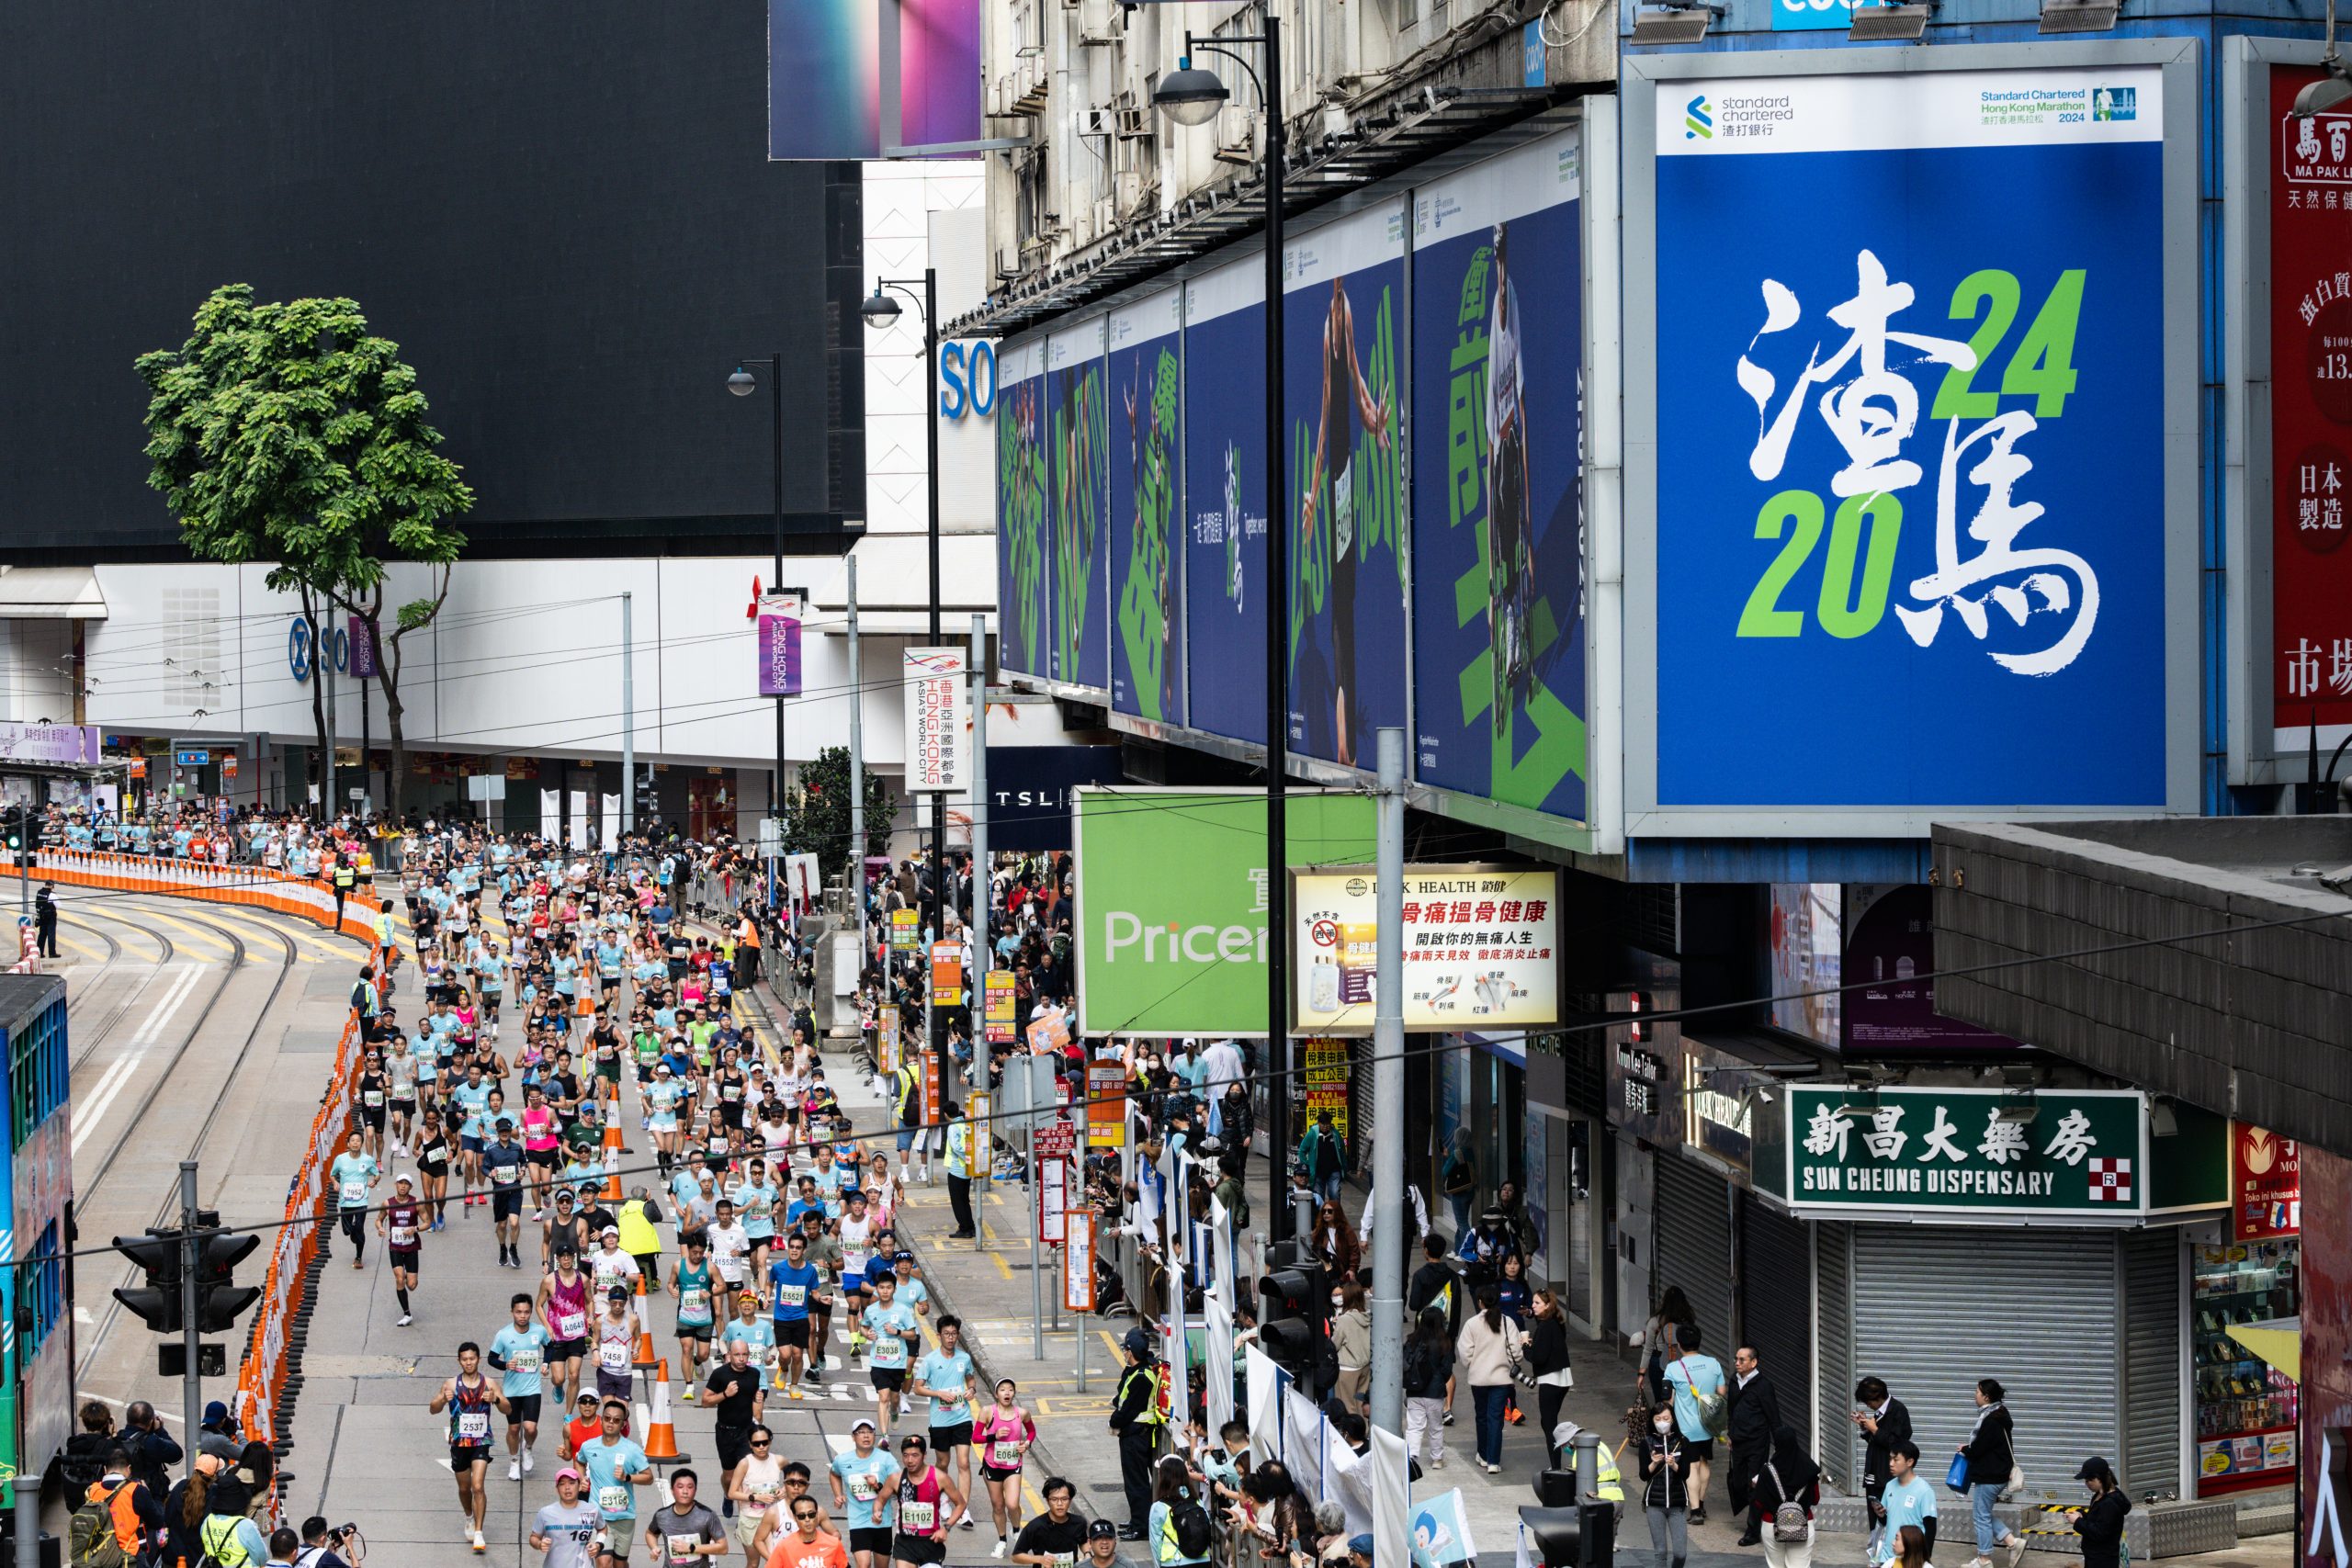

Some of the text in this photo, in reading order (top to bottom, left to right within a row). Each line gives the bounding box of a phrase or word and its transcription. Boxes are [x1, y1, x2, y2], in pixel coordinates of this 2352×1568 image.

[1981, 88, 2086, 102] Standard Chartered
[1722, 96, 1790, 109] standard
[1981, 101, 2086, 115] Hong Kong Marathon
[1722, 107, 1793, 122] chartered
[2058, 113, 2086, 123] 2024
[1723, 123, 1774, 137] 渣打銀行
[2295, 165, 2313, 177] MA
[2316, 166, 2339, 178] PAK
[1929, 268, 2087, 420] 24
[2301, 462, 2342, 495] 日本
[2299, 498, 2343, 531] 製造
[1736, 489, 1904, 638] 20
[777, 620, 786, 690] HONG KONG
[918, 681, 926, 716] ASIA'S
[926, 679, 940, 784] HONG KONG
[919, 758, 927, 784] CITY
[996, 791, 1053, 807] TSL
[1419, 881, 1476, 893] HEALTH
[1641, 1053, 1657, 1081] Tailor
[1090, 1081, 1101, 1089] 15B
[1102, 1081, 1113, 1089] 601
[1802, 1102, 2098, 1167] 新昌大藥房
[1803, 1166, 2054, 1196] SUN CHEUNG DISPENSARY
[2245, 1190, 2294, 1203] Toko ini khusus
[597, 1276, 618, 1285] E5202
[782, 1292, 804, 1301] E5521
[564, 1320, 585, 1332] A0649
[603, 1351, 622, 1362] 7458
[876, 1346, 899, 1355] E3038
[463, 1422, 484, 1432] 2537
[904, 1512, 933, 1523] E1102
